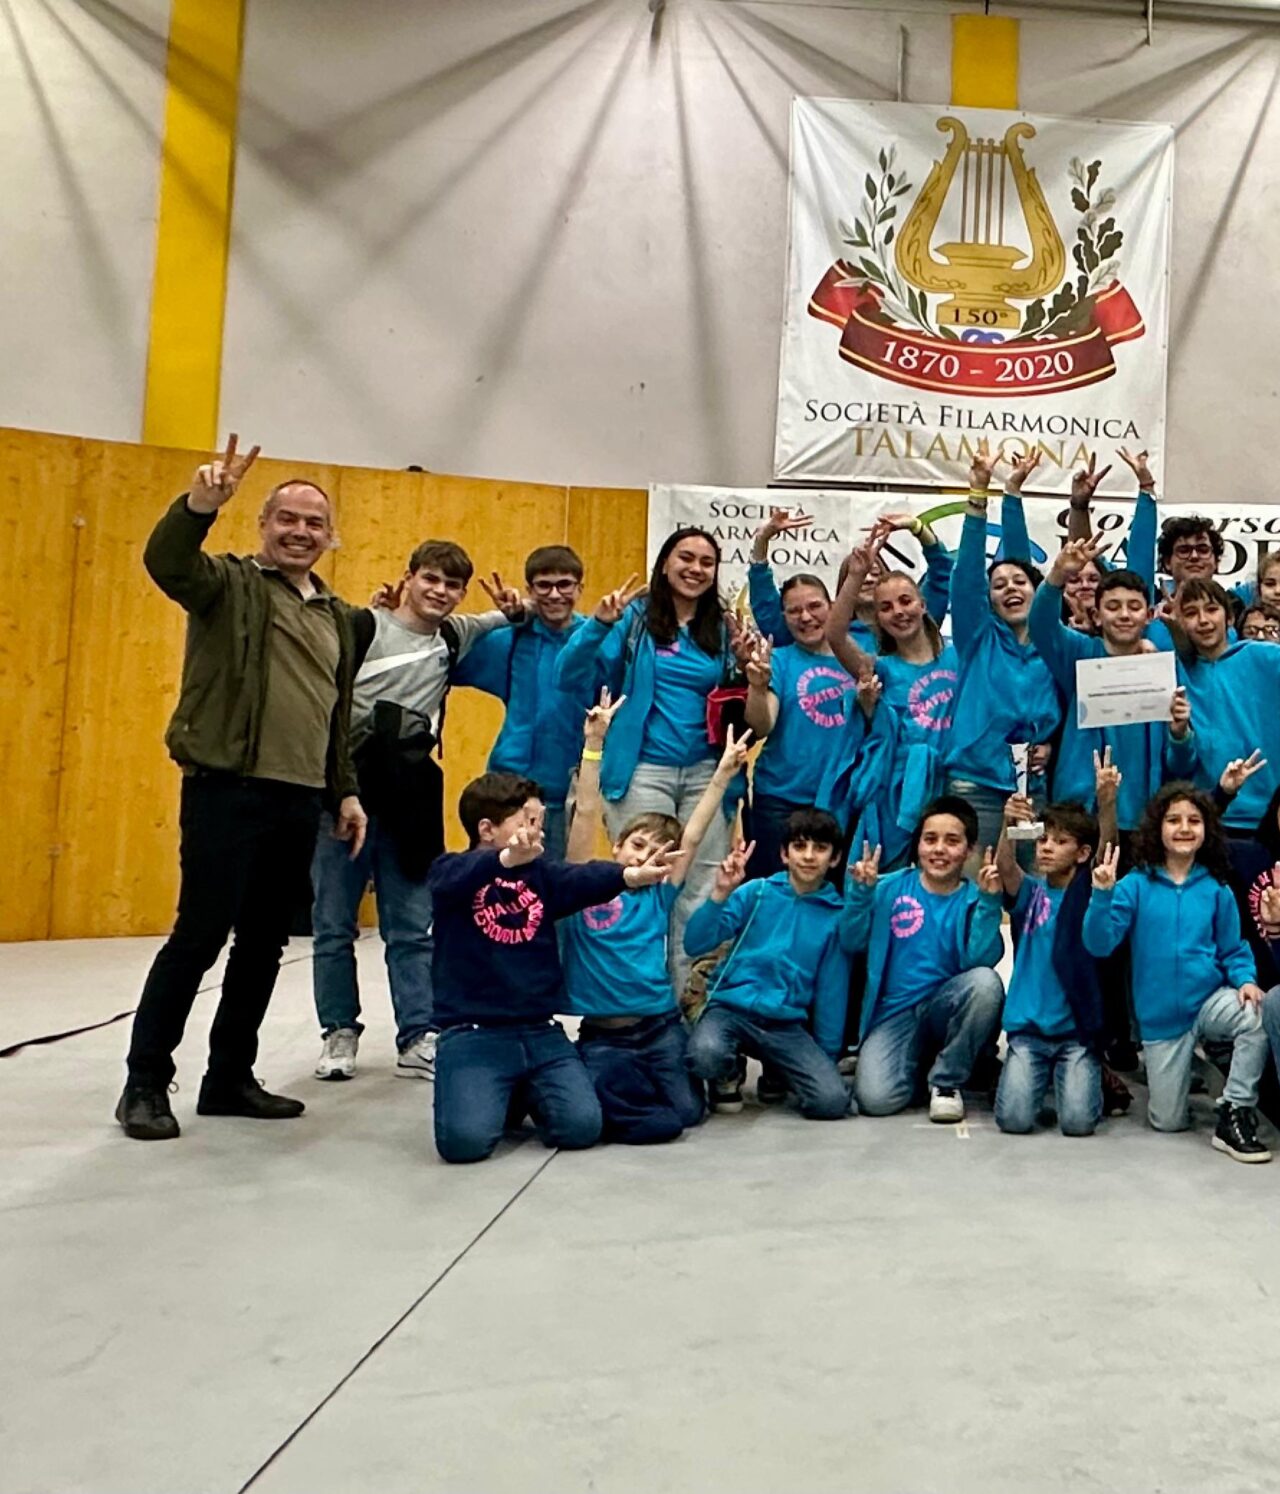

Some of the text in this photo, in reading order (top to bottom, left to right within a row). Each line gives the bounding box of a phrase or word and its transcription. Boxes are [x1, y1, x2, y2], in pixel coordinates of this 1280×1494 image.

[880, 341, 960, 378] 1870
[995, 351, 1074, 382] 2020
[939, 405, 1140, 439] FILARMONICA
